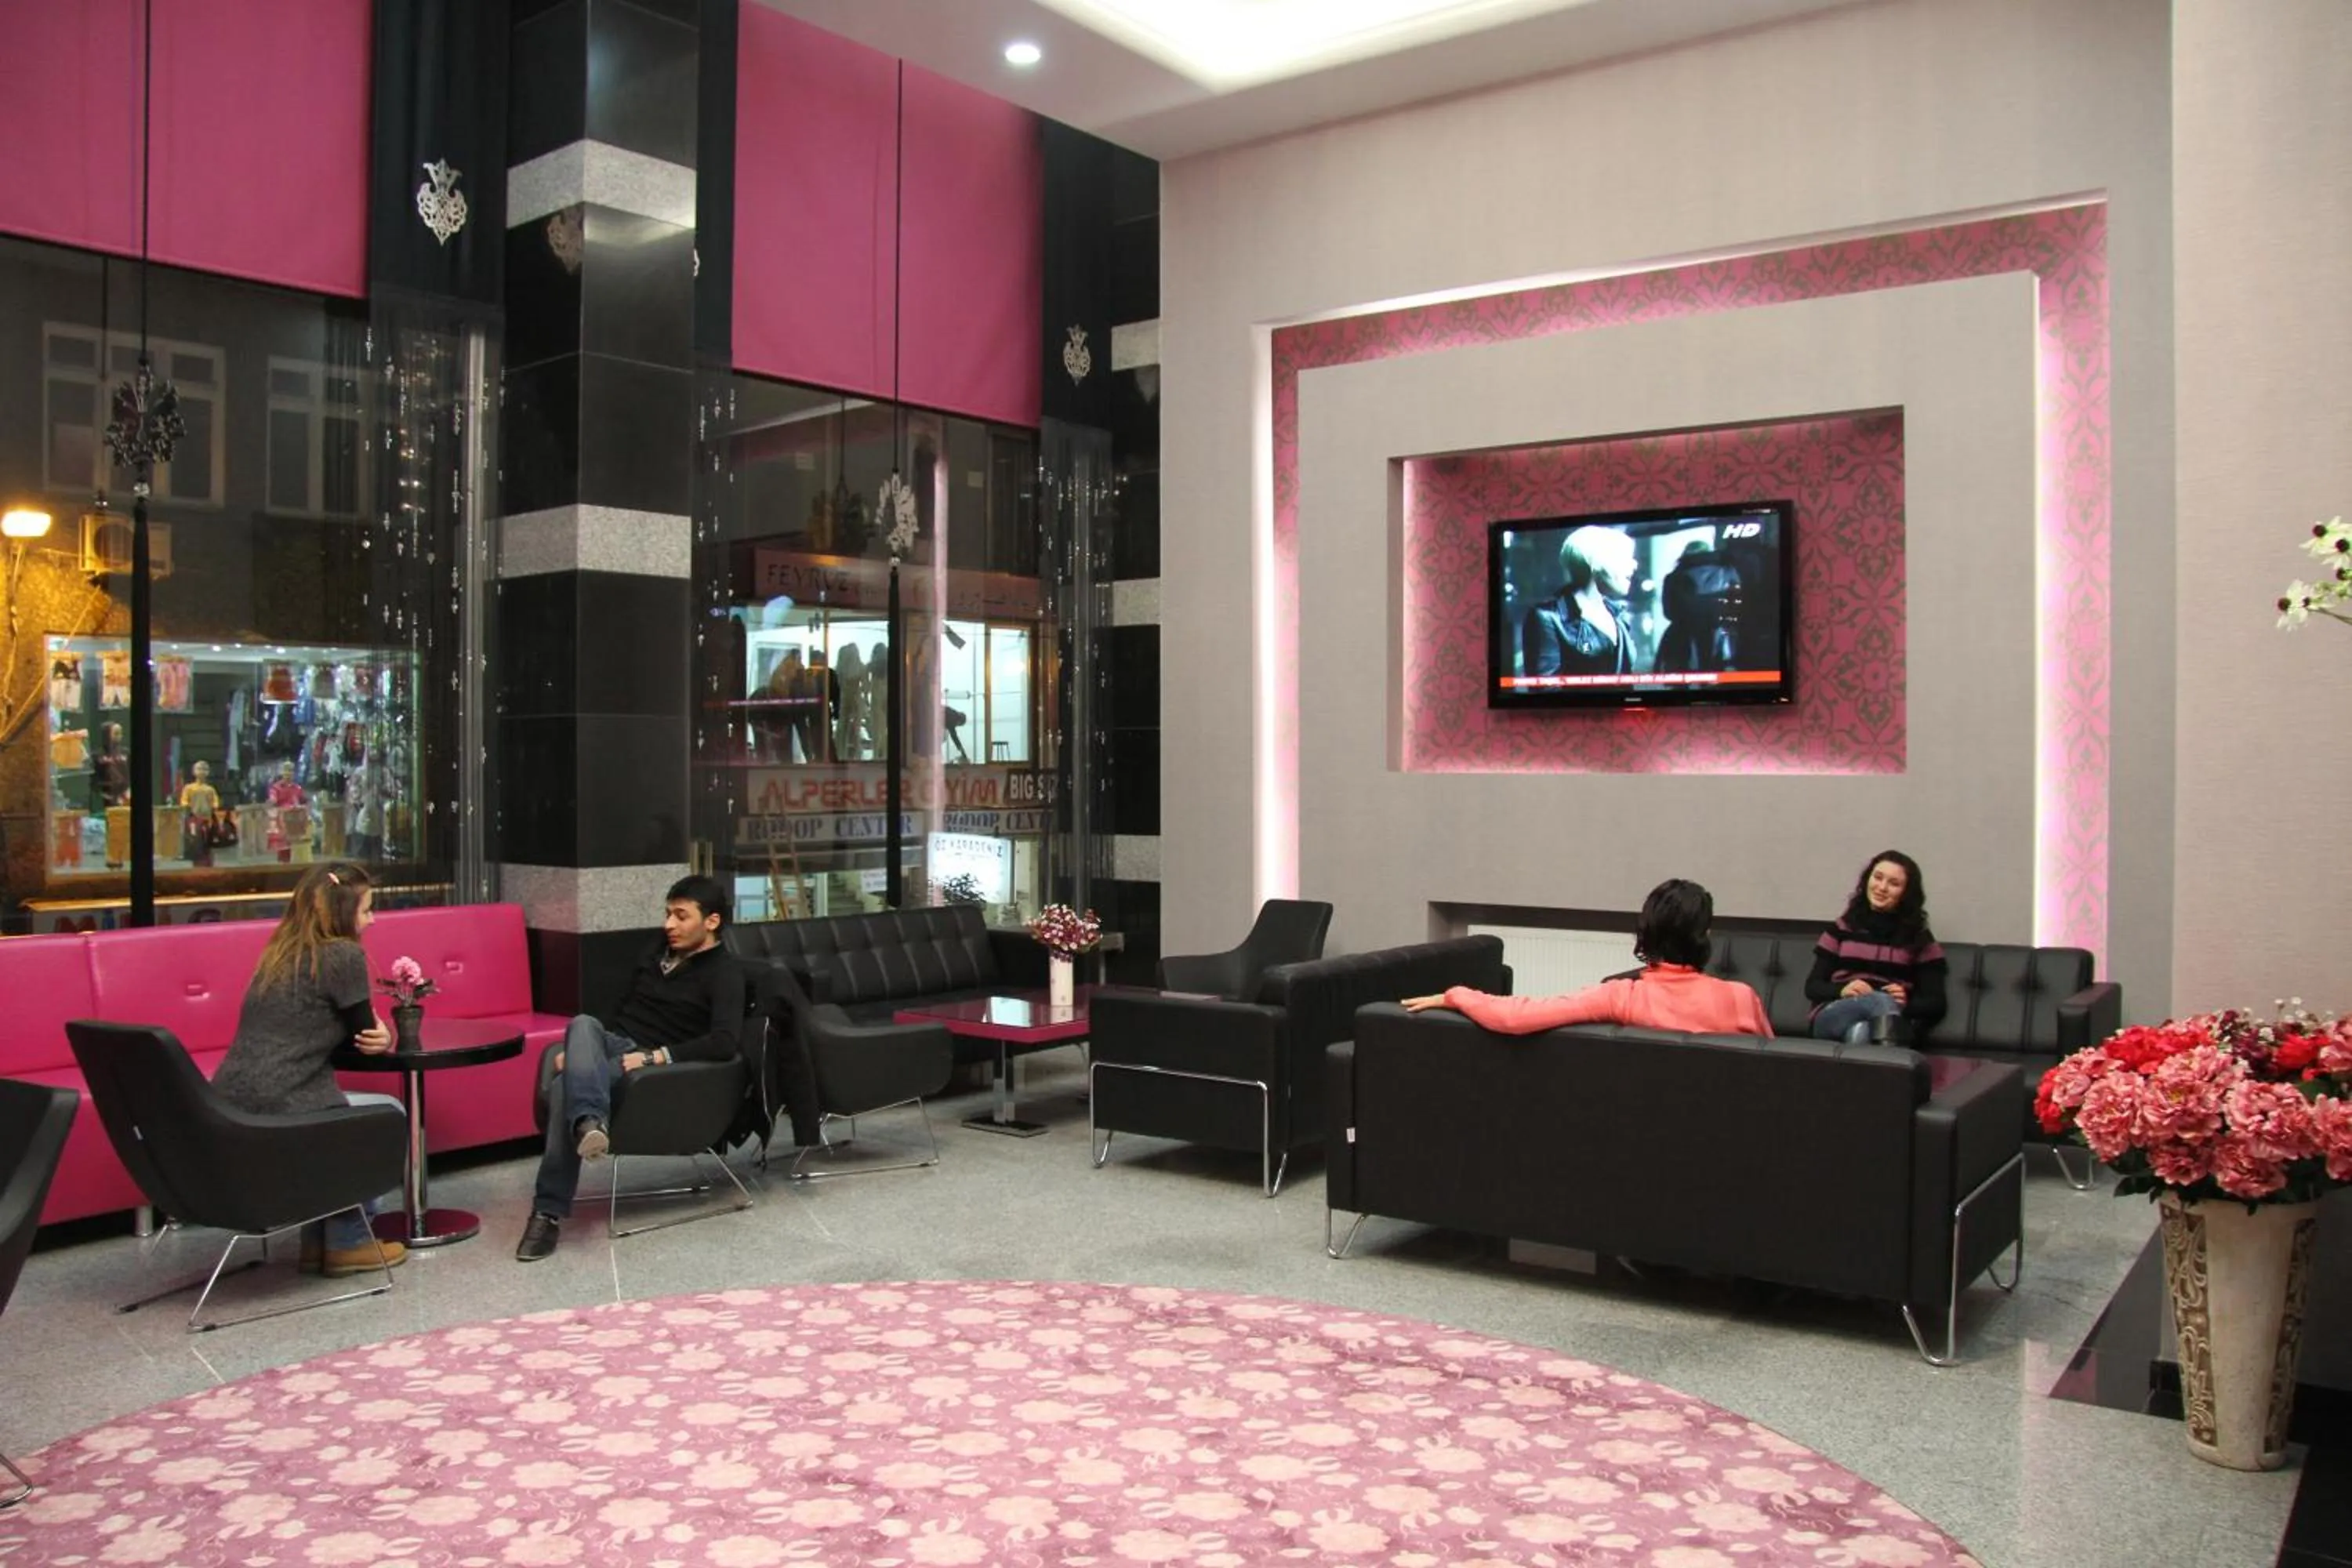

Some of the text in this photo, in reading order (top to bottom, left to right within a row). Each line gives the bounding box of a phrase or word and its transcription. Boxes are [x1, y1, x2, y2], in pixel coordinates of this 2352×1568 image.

[1722, 523, 1761, 539] HD
[1010, 774, 1034, 800] BIG
[834, 815, 912, 838] CENTR
